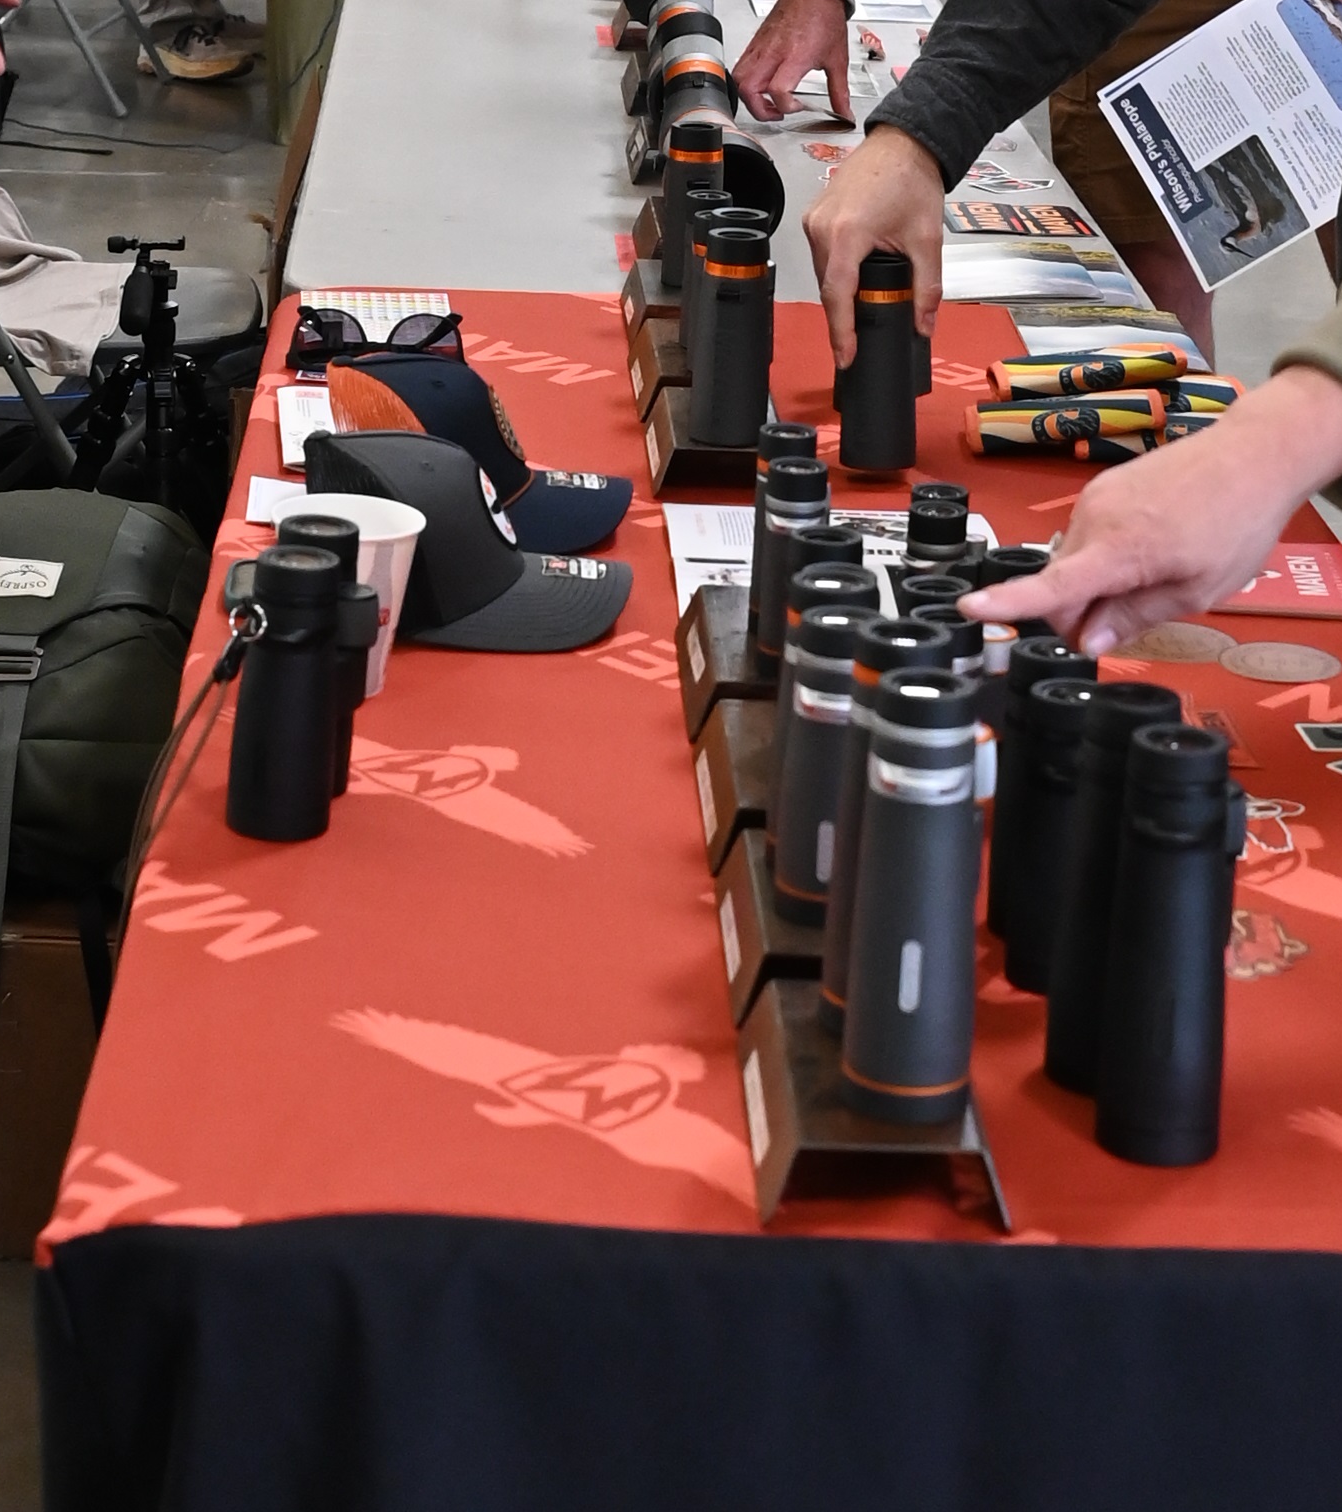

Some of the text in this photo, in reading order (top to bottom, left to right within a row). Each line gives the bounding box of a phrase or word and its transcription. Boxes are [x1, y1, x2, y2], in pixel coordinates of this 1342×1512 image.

[1120, 98, 1193, 214] Wilson's Phalarope
[1285, 555, 1330, 596] MAVEN
